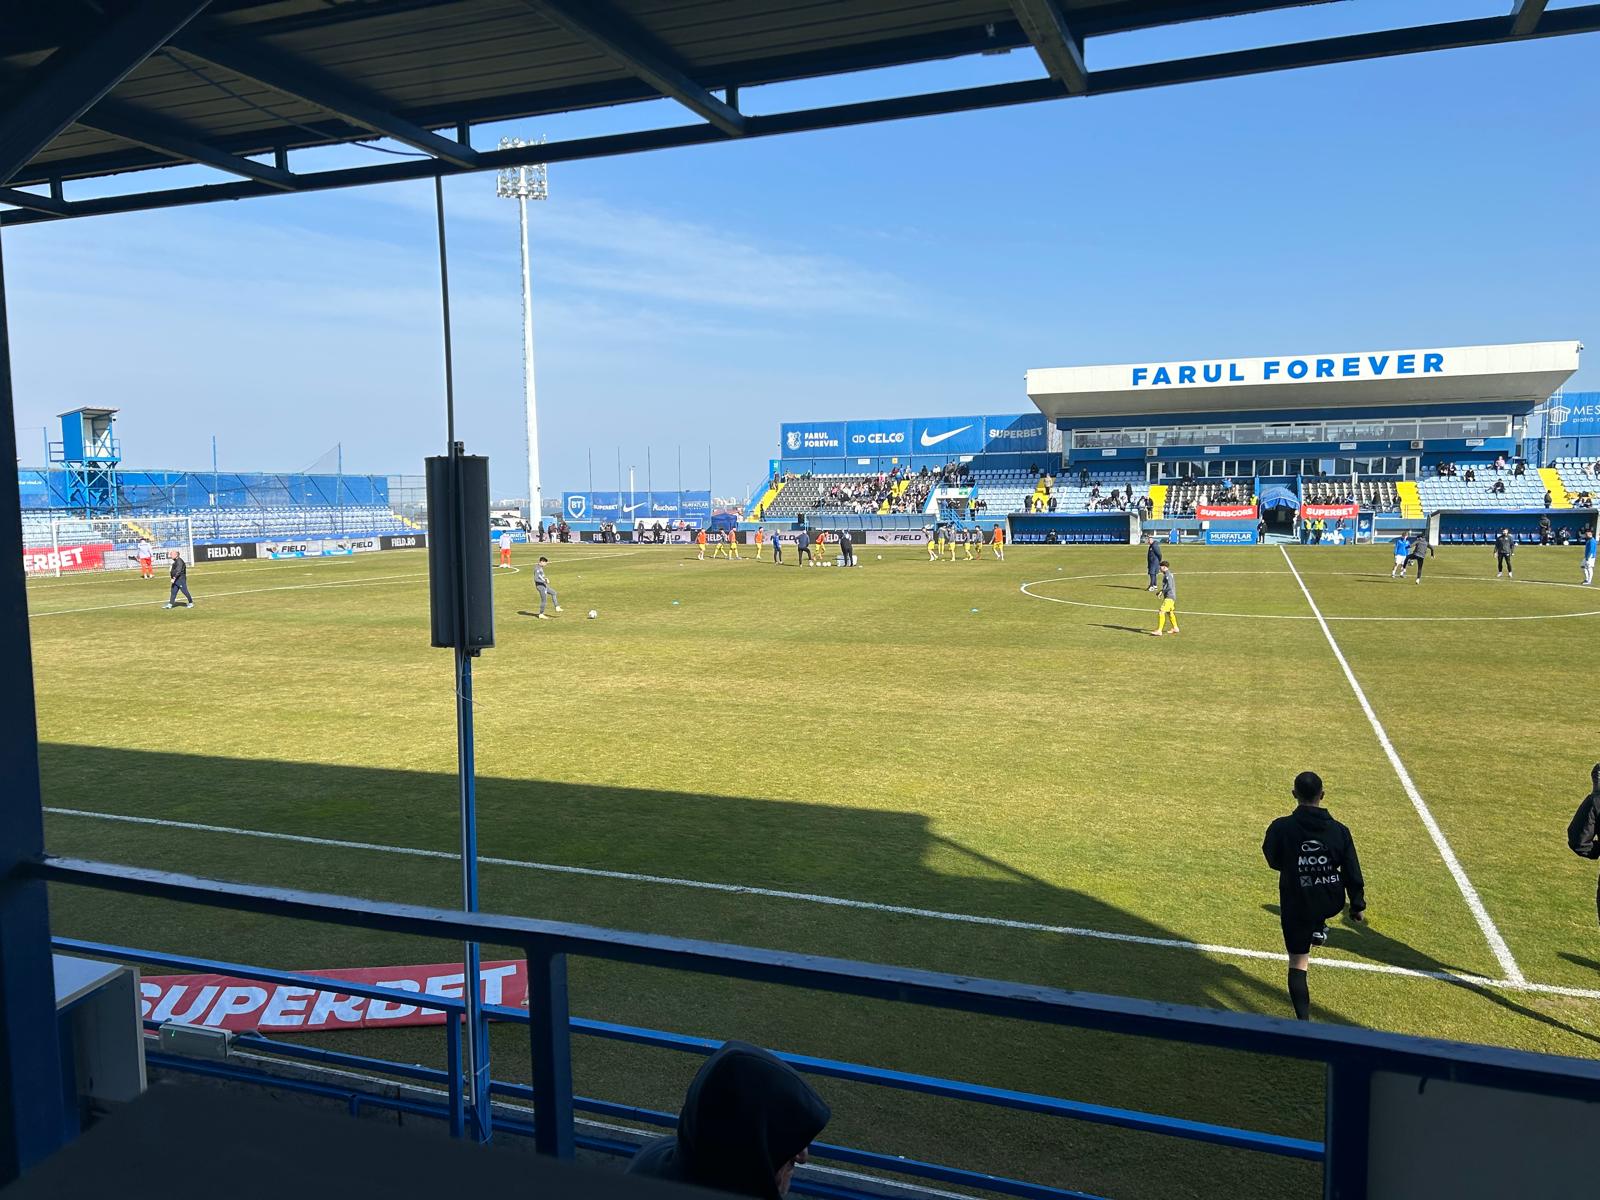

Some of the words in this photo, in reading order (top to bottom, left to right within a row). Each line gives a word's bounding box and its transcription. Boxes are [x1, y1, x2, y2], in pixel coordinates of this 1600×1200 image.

[1132, 363, 1245, 386] FARUL
[1263, 353, 1444, 380] FOREVER
[804, 432, 829, 440] FARUL
[867, 432, 905, 444] CELCO
[989, 426, 1043, 439] SUPERBET
[804, 439, 839, 448] FOREVER
[571, 501, 581, 509] BT
[652, 503, 678, 511] Auchan
[1200, 507, 1253, 518] SUPERSCORE
[1306, 506, 1354, 517] SUPERBET
[351, 540, 373, 549] FIELD
[391, 537, 416, 547] FIELD.RO
[207, 546, 242, 558] FIELD.RO
[281, 544, 307, 553] FIELD
[22, 547, 84, 571] ERBET
[140, 964, 517, 1026] SUPERBET
